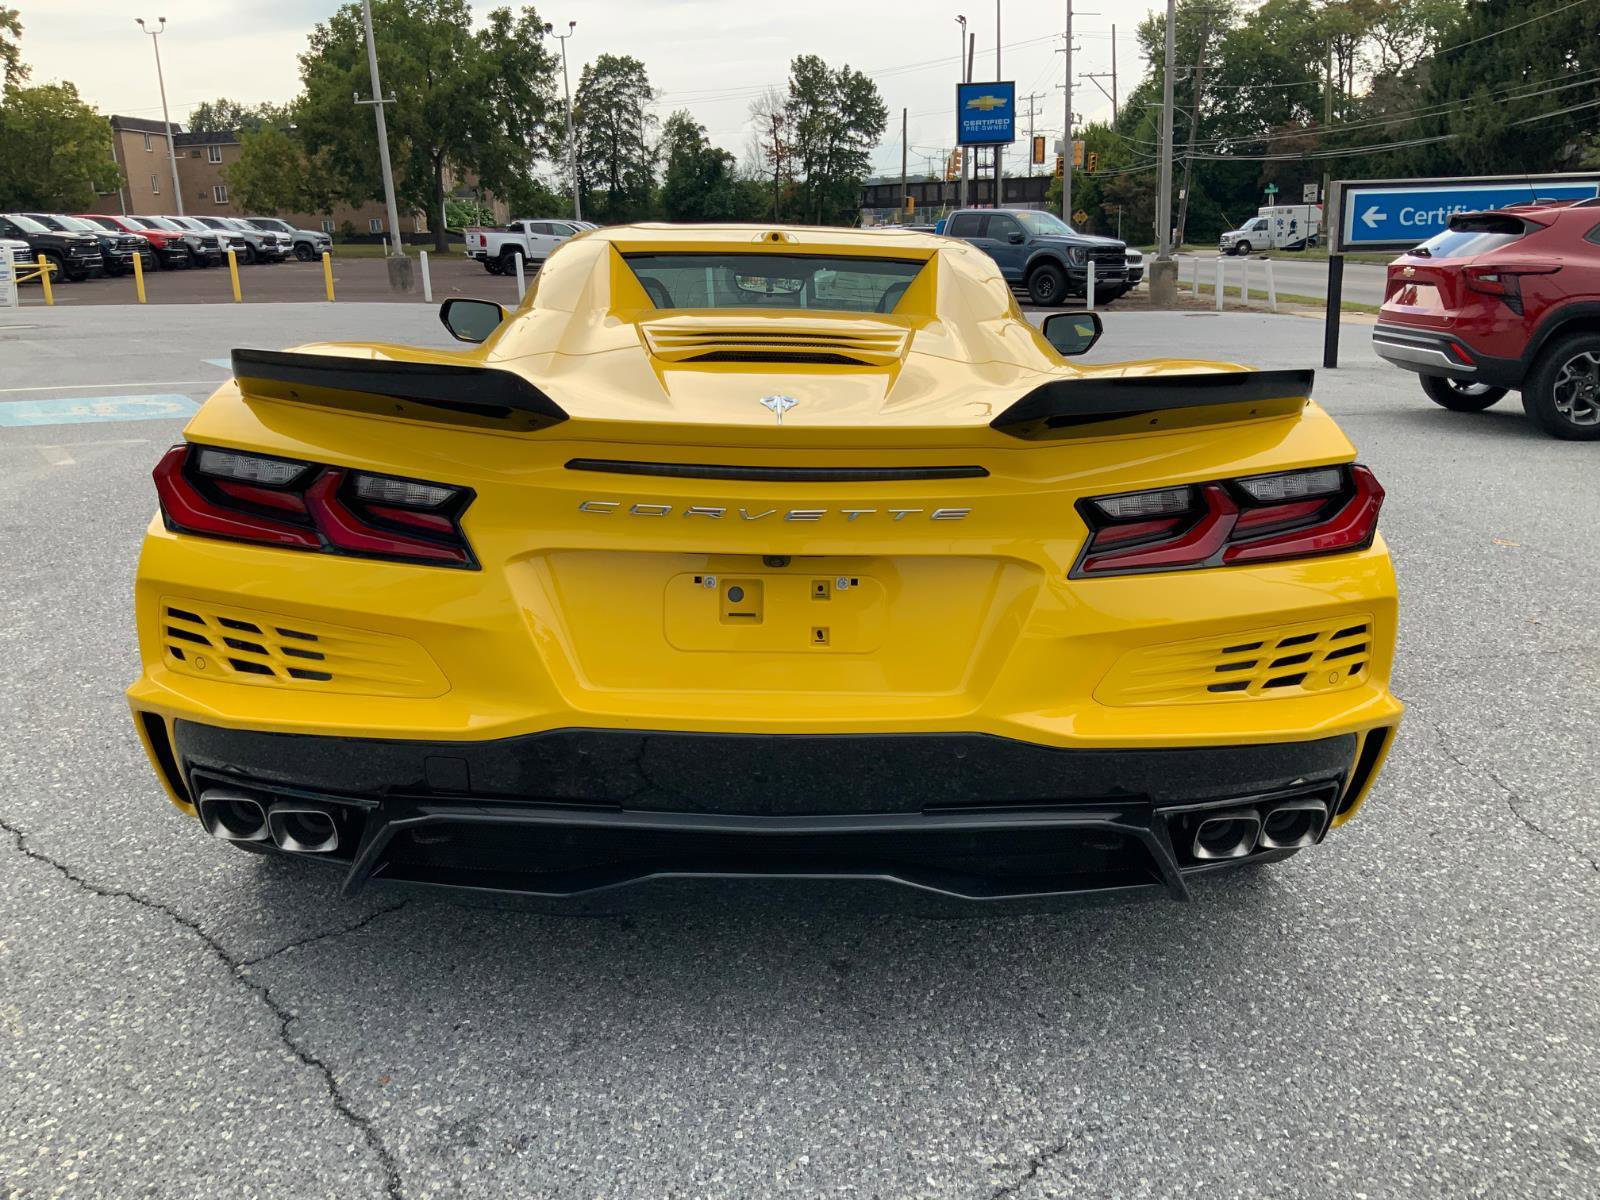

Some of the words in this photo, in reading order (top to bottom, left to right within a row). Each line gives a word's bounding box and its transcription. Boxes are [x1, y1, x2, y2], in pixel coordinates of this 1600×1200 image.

[963, 118, 1010, 127] CERTIFIED
[966, 124, 1008, 132] PRE-OWNED
[1399, 204, 1494, 226] Certifi
[578, 500, 972, 521] CORVETTE
